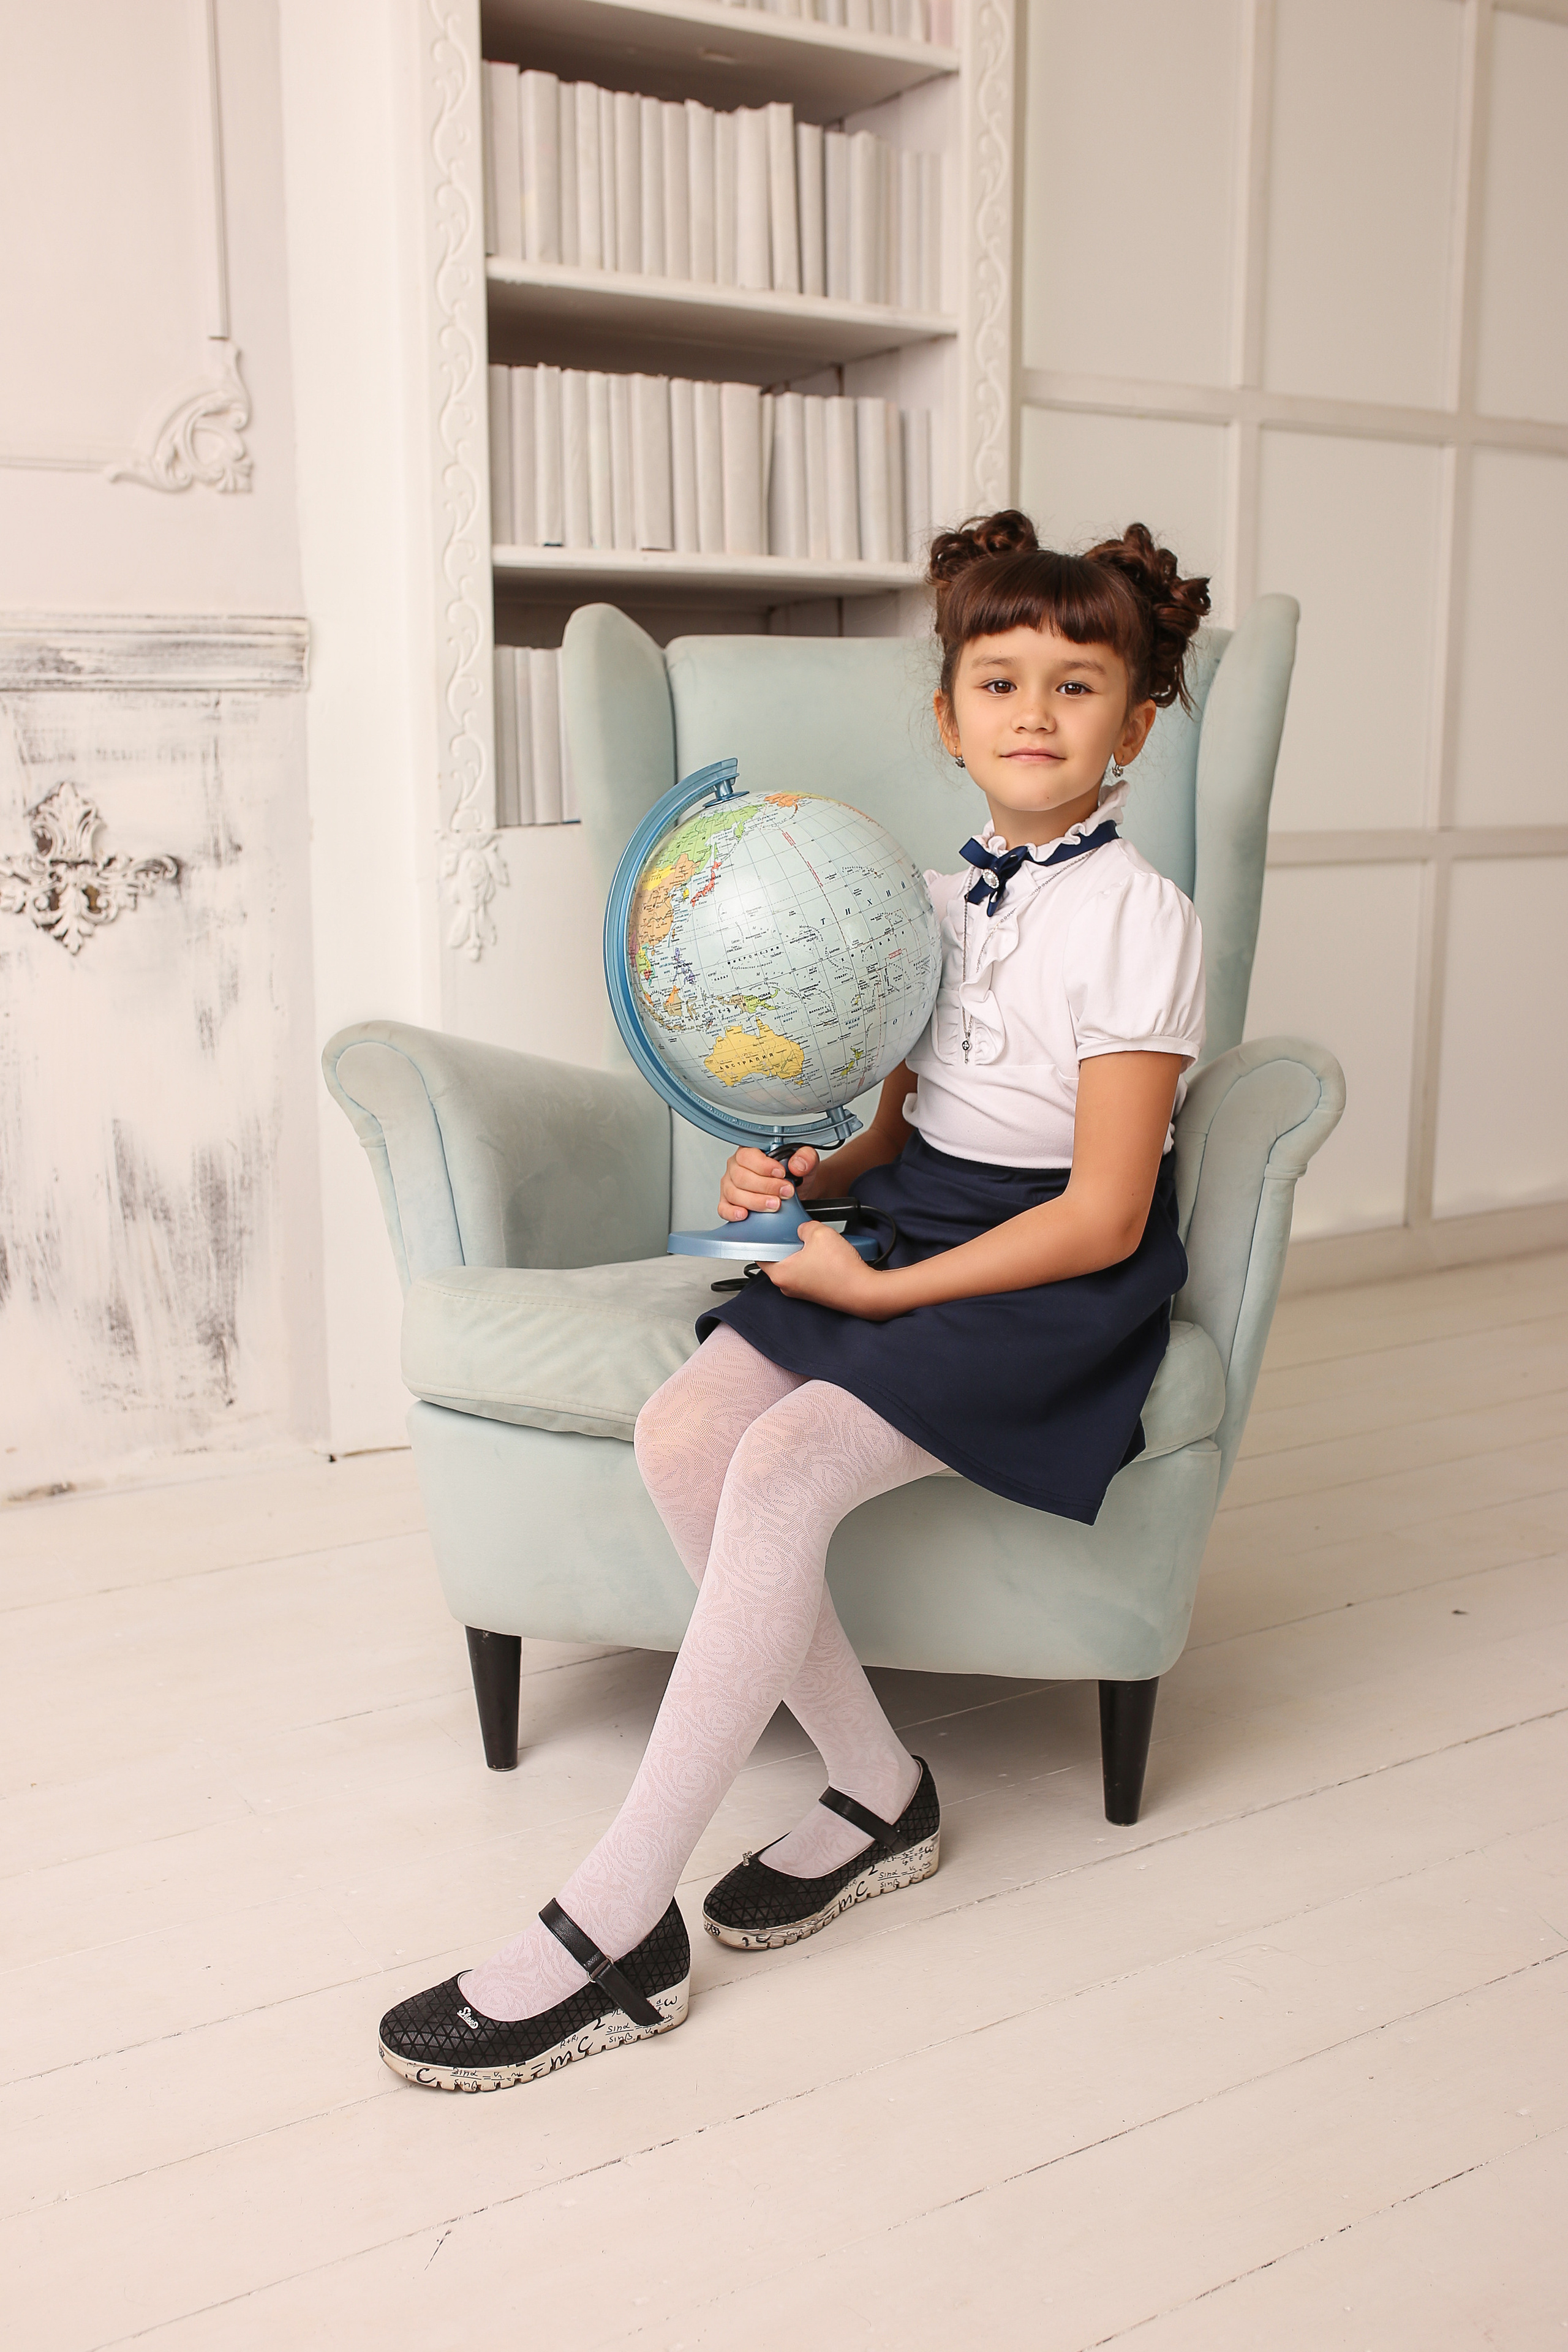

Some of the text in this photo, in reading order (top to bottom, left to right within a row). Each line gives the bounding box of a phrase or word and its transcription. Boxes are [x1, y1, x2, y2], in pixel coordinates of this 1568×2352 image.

[727, 946, 779, 965] МИКРОНЕЗИЯ
[719, 1052, 774, 1071] АВСТРАЛИЯ
[456, 2007, 479, 2029] Shoes
